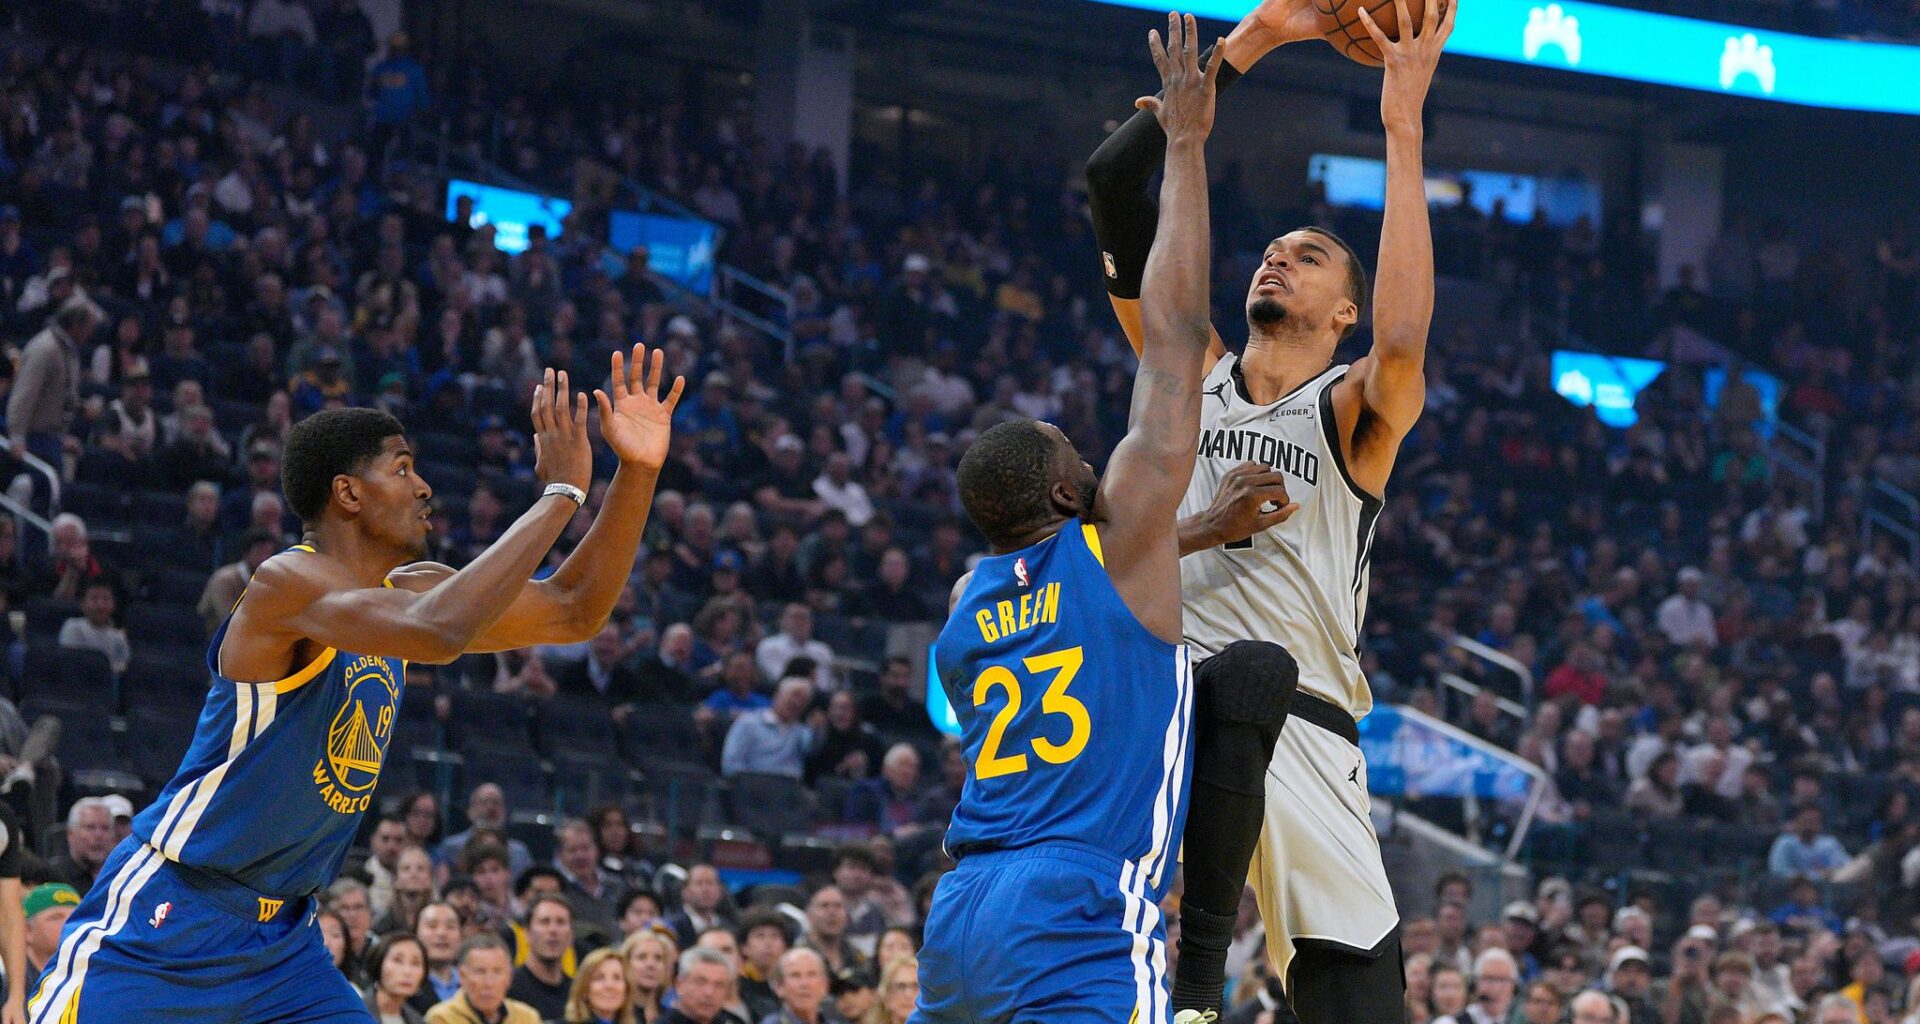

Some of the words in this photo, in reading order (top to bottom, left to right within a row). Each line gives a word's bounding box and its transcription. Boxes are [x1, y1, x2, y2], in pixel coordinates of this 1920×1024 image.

[1275, 408, 1309, 418] LEDGER
[975, 582, 1061, 644] GREEN
[375, 705, 392, 738] 19
[973, 645, 1091, 781] 23
